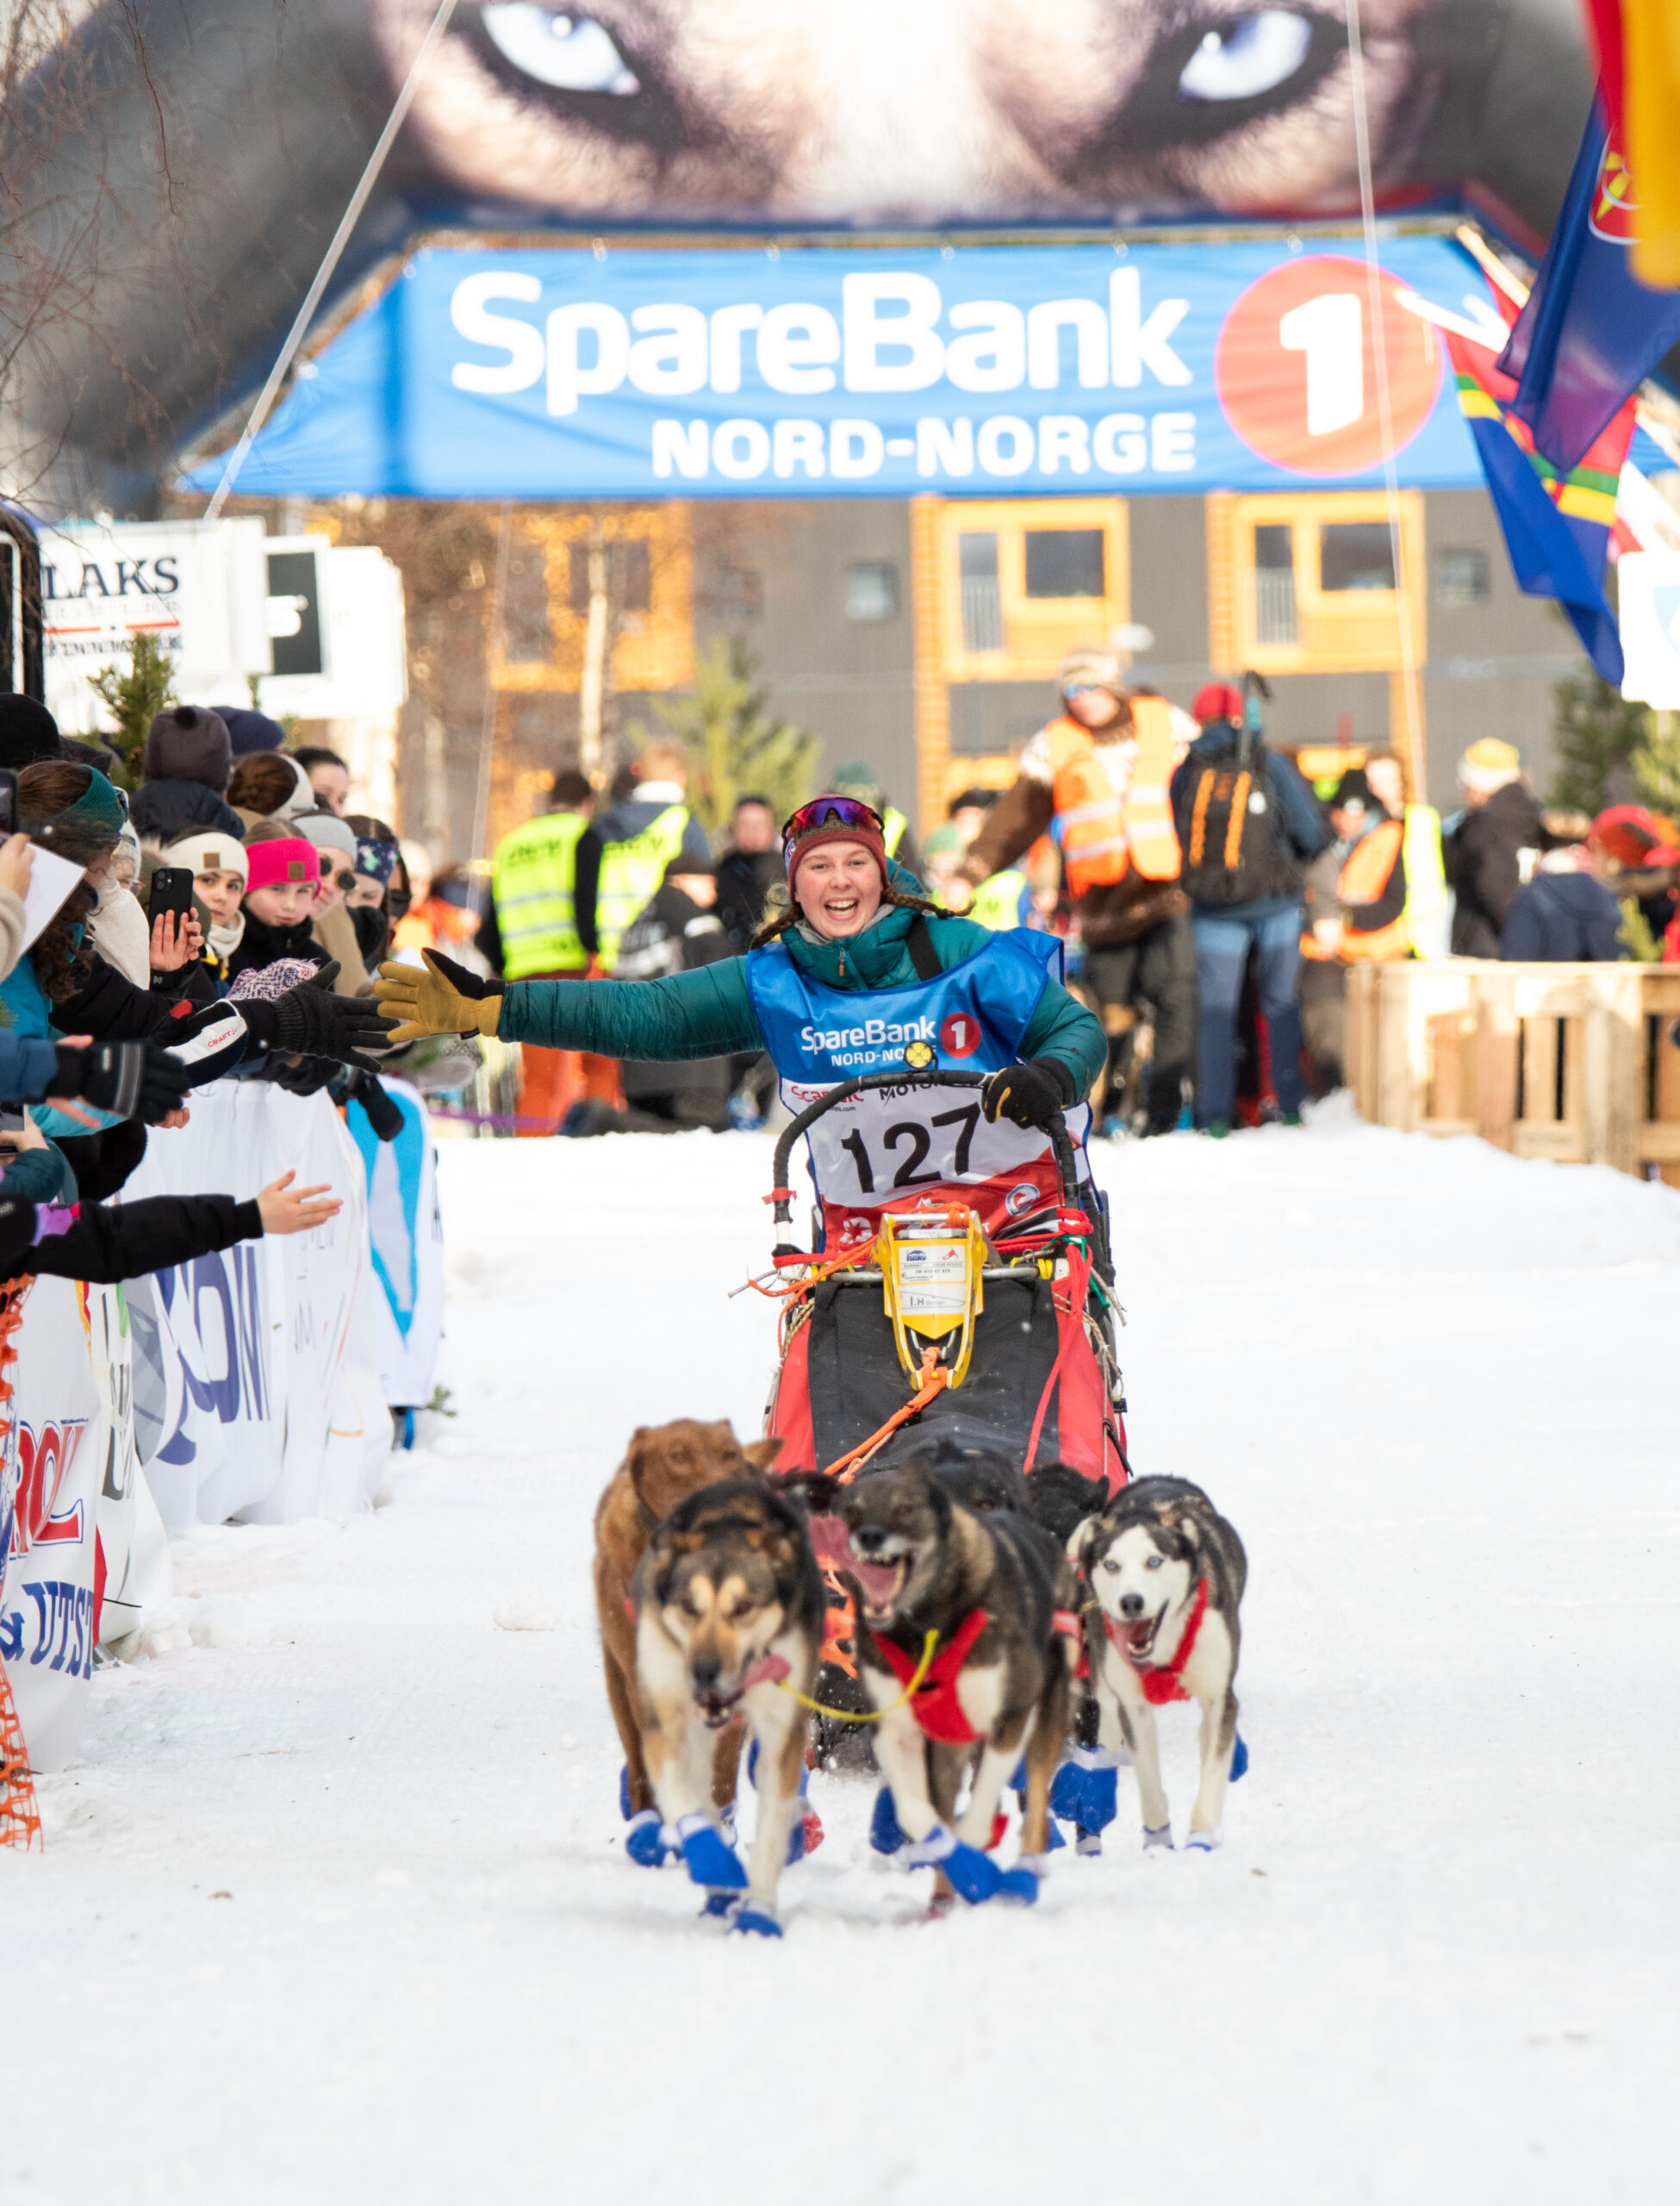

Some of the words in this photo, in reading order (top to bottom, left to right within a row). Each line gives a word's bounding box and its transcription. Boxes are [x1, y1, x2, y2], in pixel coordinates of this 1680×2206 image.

[450, 267, 1193, 417] SpareBank
[1279, 294, 1363, 436] 1
[655, 415, 1196, 479] NORD-NORGE
[208, 1030, 231, 1048] CRAFT
[801, 1016, 936, 1056] SpareBank
[831, 1046, 937, 1066] NORD-NO
[841, 1101, 981, 1194] 127
